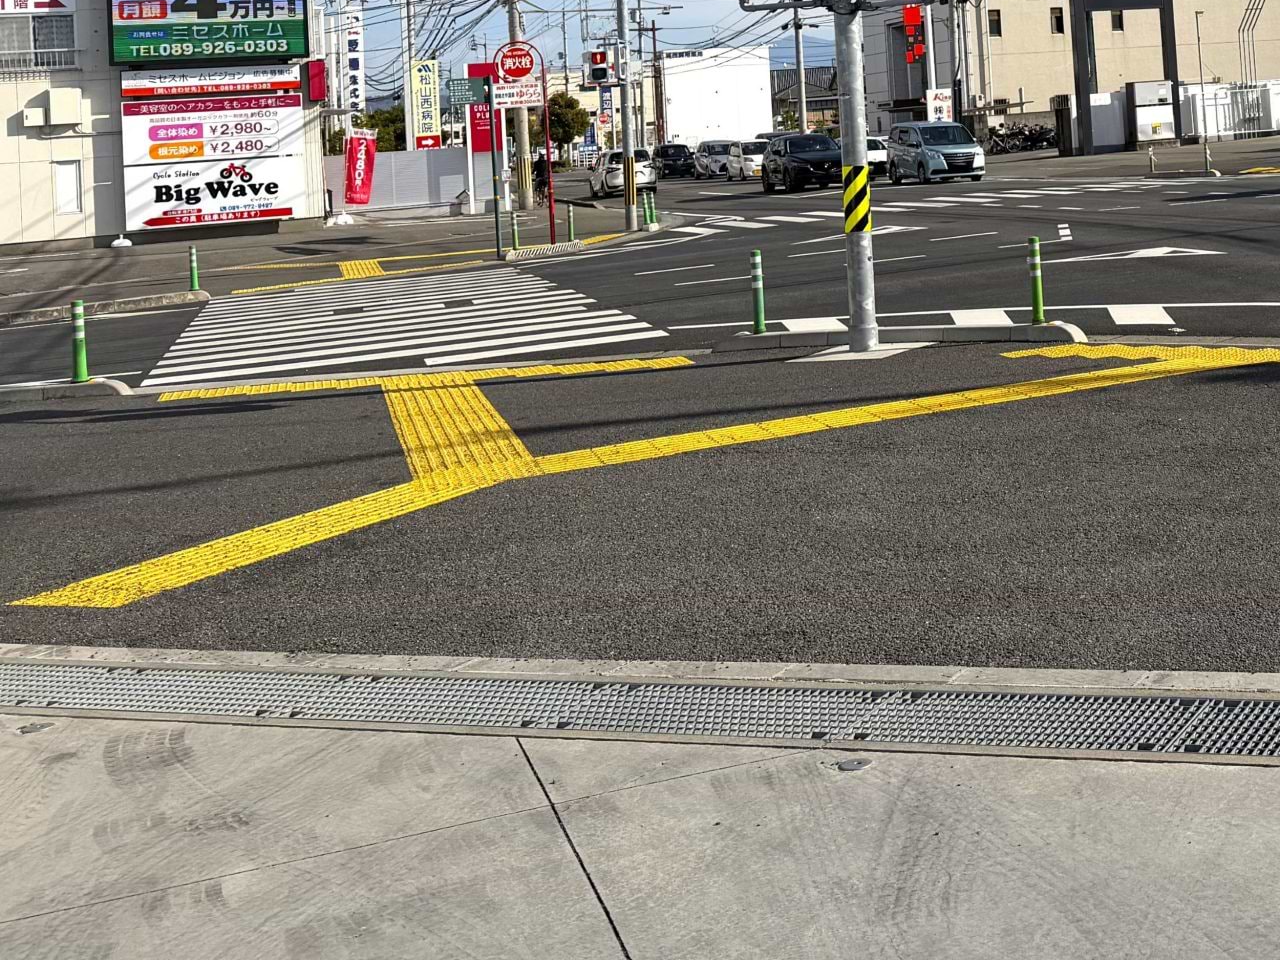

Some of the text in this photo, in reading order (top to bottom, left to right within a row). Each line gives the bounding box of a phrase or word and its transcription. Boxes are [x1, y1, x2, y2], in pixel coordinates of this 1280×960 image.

[122, 1, 161, 18] 月額
[172, 22, 284, 40] ミセスホーム
[503, 56, 532, 70] 消火栓
[148, 71, 246, 84] ミセスホームビジョン
[516, 89, 541, 99] ゆらら
[419, 74, 434, 133] 松山西病院
[157, 128, 198, 139] 全体染め
[158, 146, 199, 156] 根元染め
[153, 180, 279, 205] Big Wave
